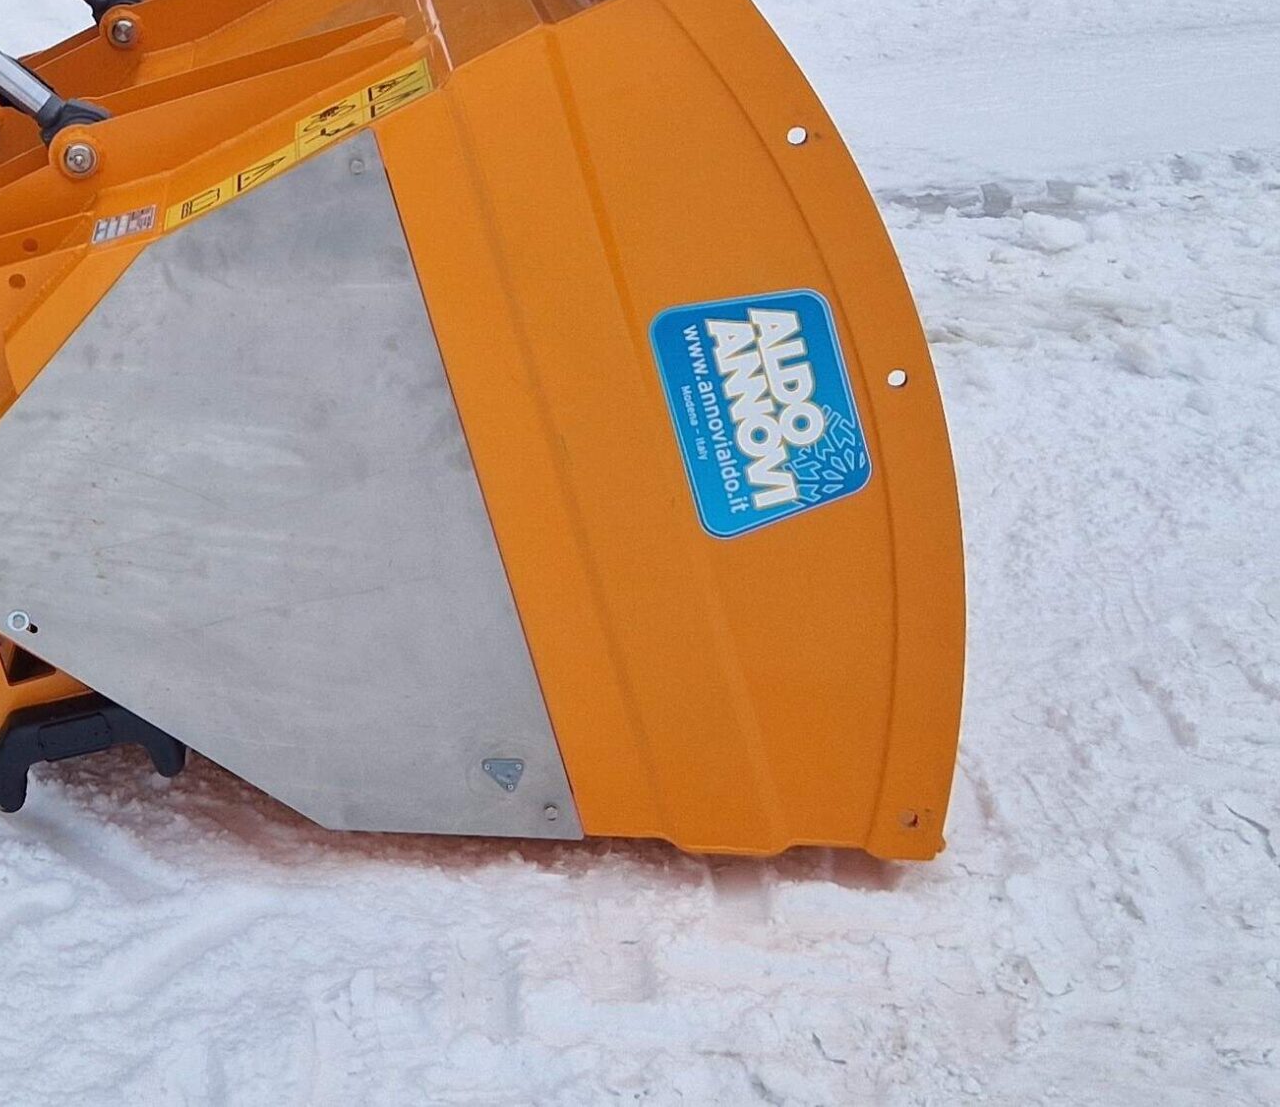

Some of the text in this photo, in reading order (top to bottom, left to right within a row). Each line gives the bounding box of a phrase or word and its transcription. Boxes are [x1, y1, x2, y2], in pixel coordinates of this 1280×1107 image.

[681, 385, 698, 427] Modena
[695, 437, 708, 461] Italy
[682, 324, 750, 514] www.annovialdo.it
[705, 319, 798, 510] ANNOVI
[747, 307, 826, 445] ALDO
